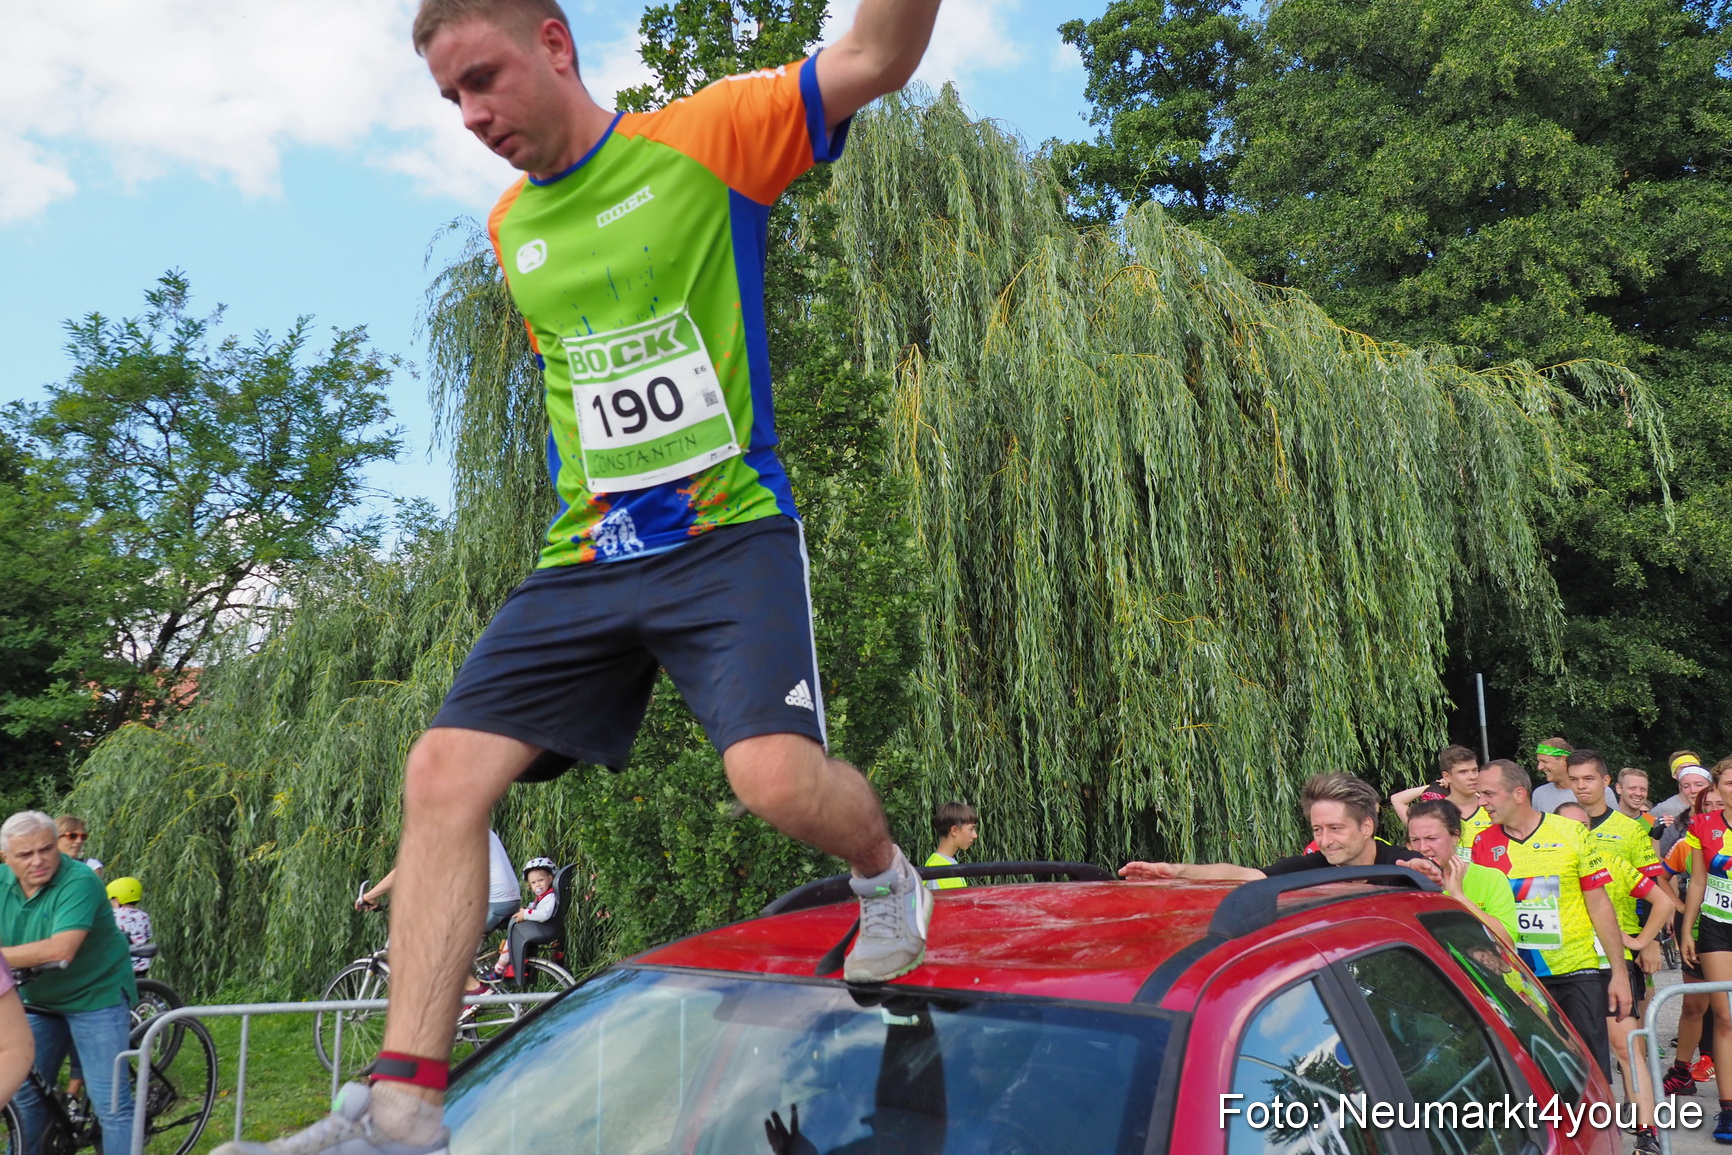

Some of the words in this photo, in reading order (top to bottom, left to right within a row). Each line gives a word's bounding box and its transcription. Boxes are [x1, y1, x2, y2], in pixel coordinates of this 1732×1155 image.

[596, 185, 655, 229] BOCK
[566, 319, 687, 379] BOCK
[694, 365, 707, 375] E6
[592, 376, 684, 438] 190
[591, 433, 698, 475] CONSTANTIN
[1715, 893, 1732, 909] 18
